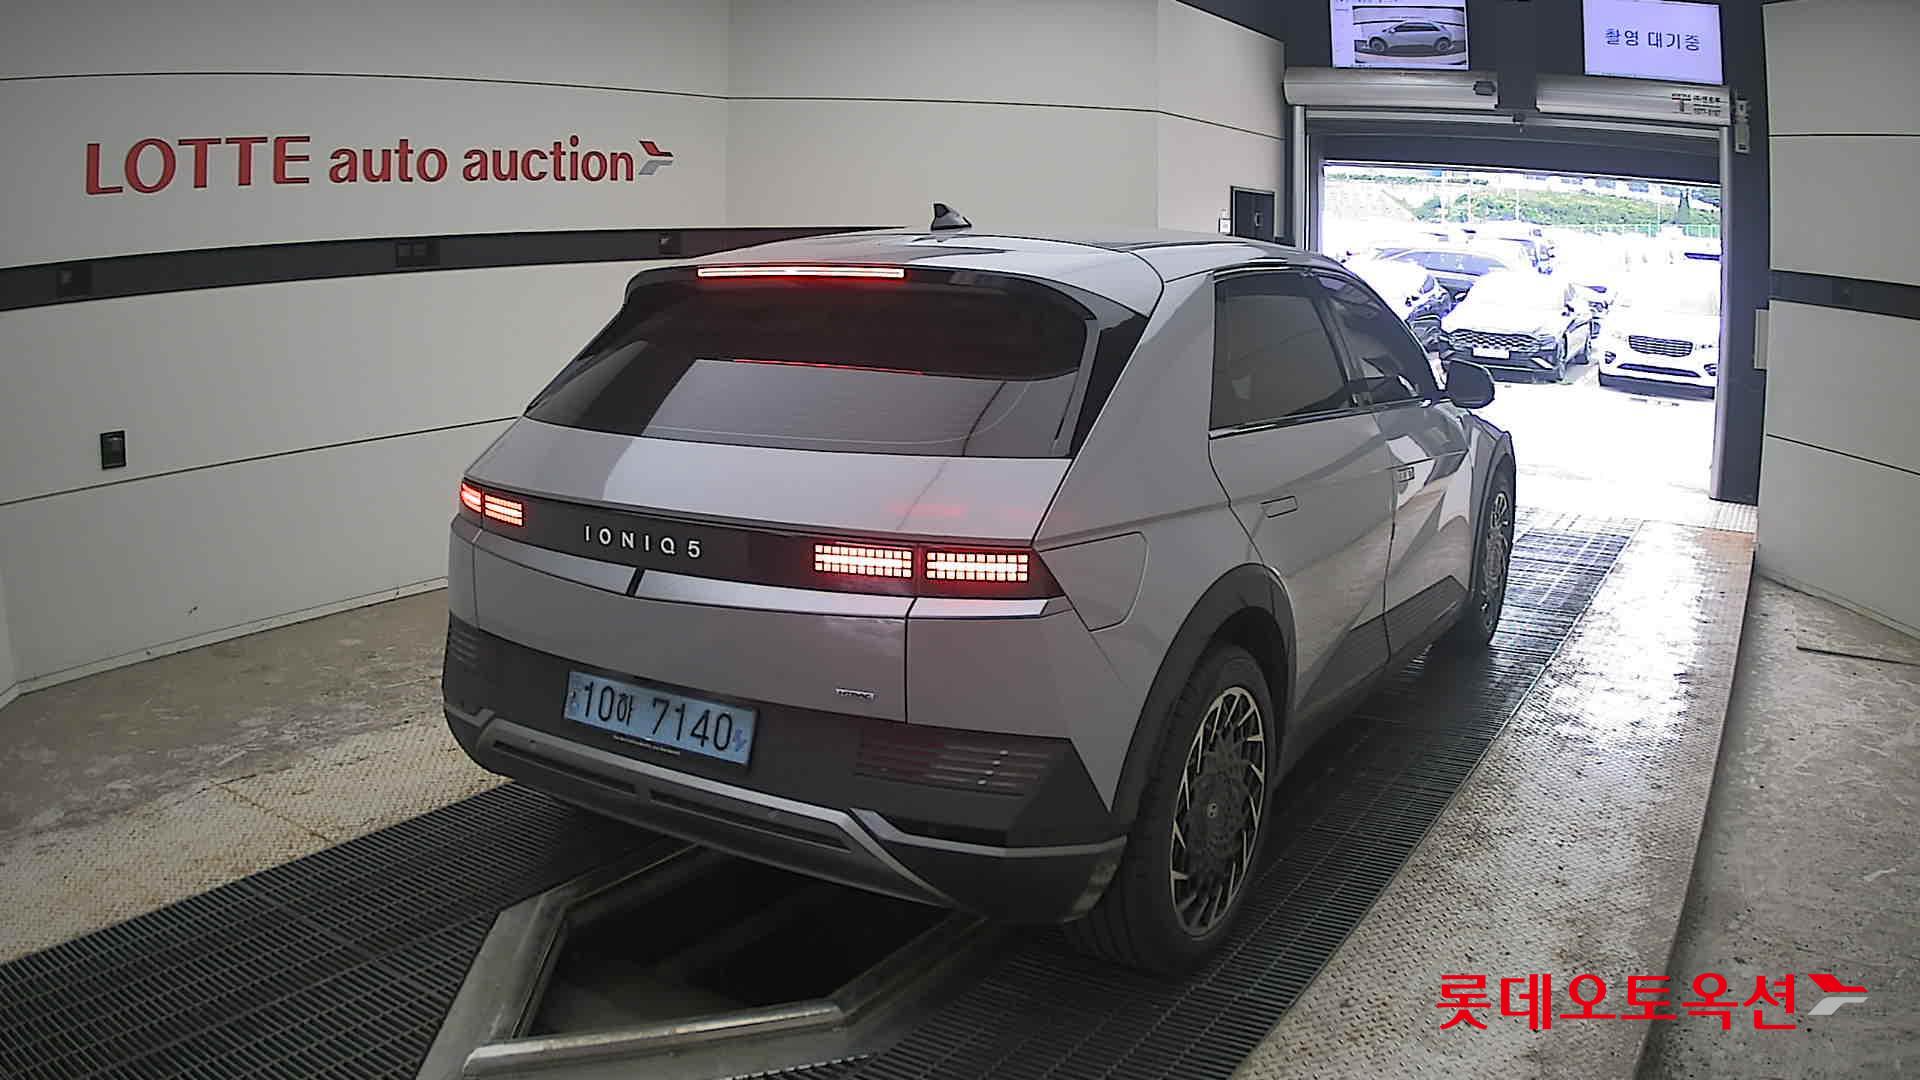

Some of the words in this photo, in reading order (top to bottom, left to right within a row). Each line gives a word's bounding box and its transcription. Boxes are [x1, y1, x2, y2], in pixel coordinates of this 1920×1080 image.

[1606, 28, 1640, 47] 촬영
[1647, 31, 1700, 52] 대기중
[86, 136, 311, 195] LOTTE
[329, 138, 448, 183] auto
[463, 135, 635, 182] auction
[584, 525, 675, 555] IONIQ
[687, 540, 701, 558] 5
[584, 680, 634, 727] 10하
[651, 697, 733, 751] 7140
